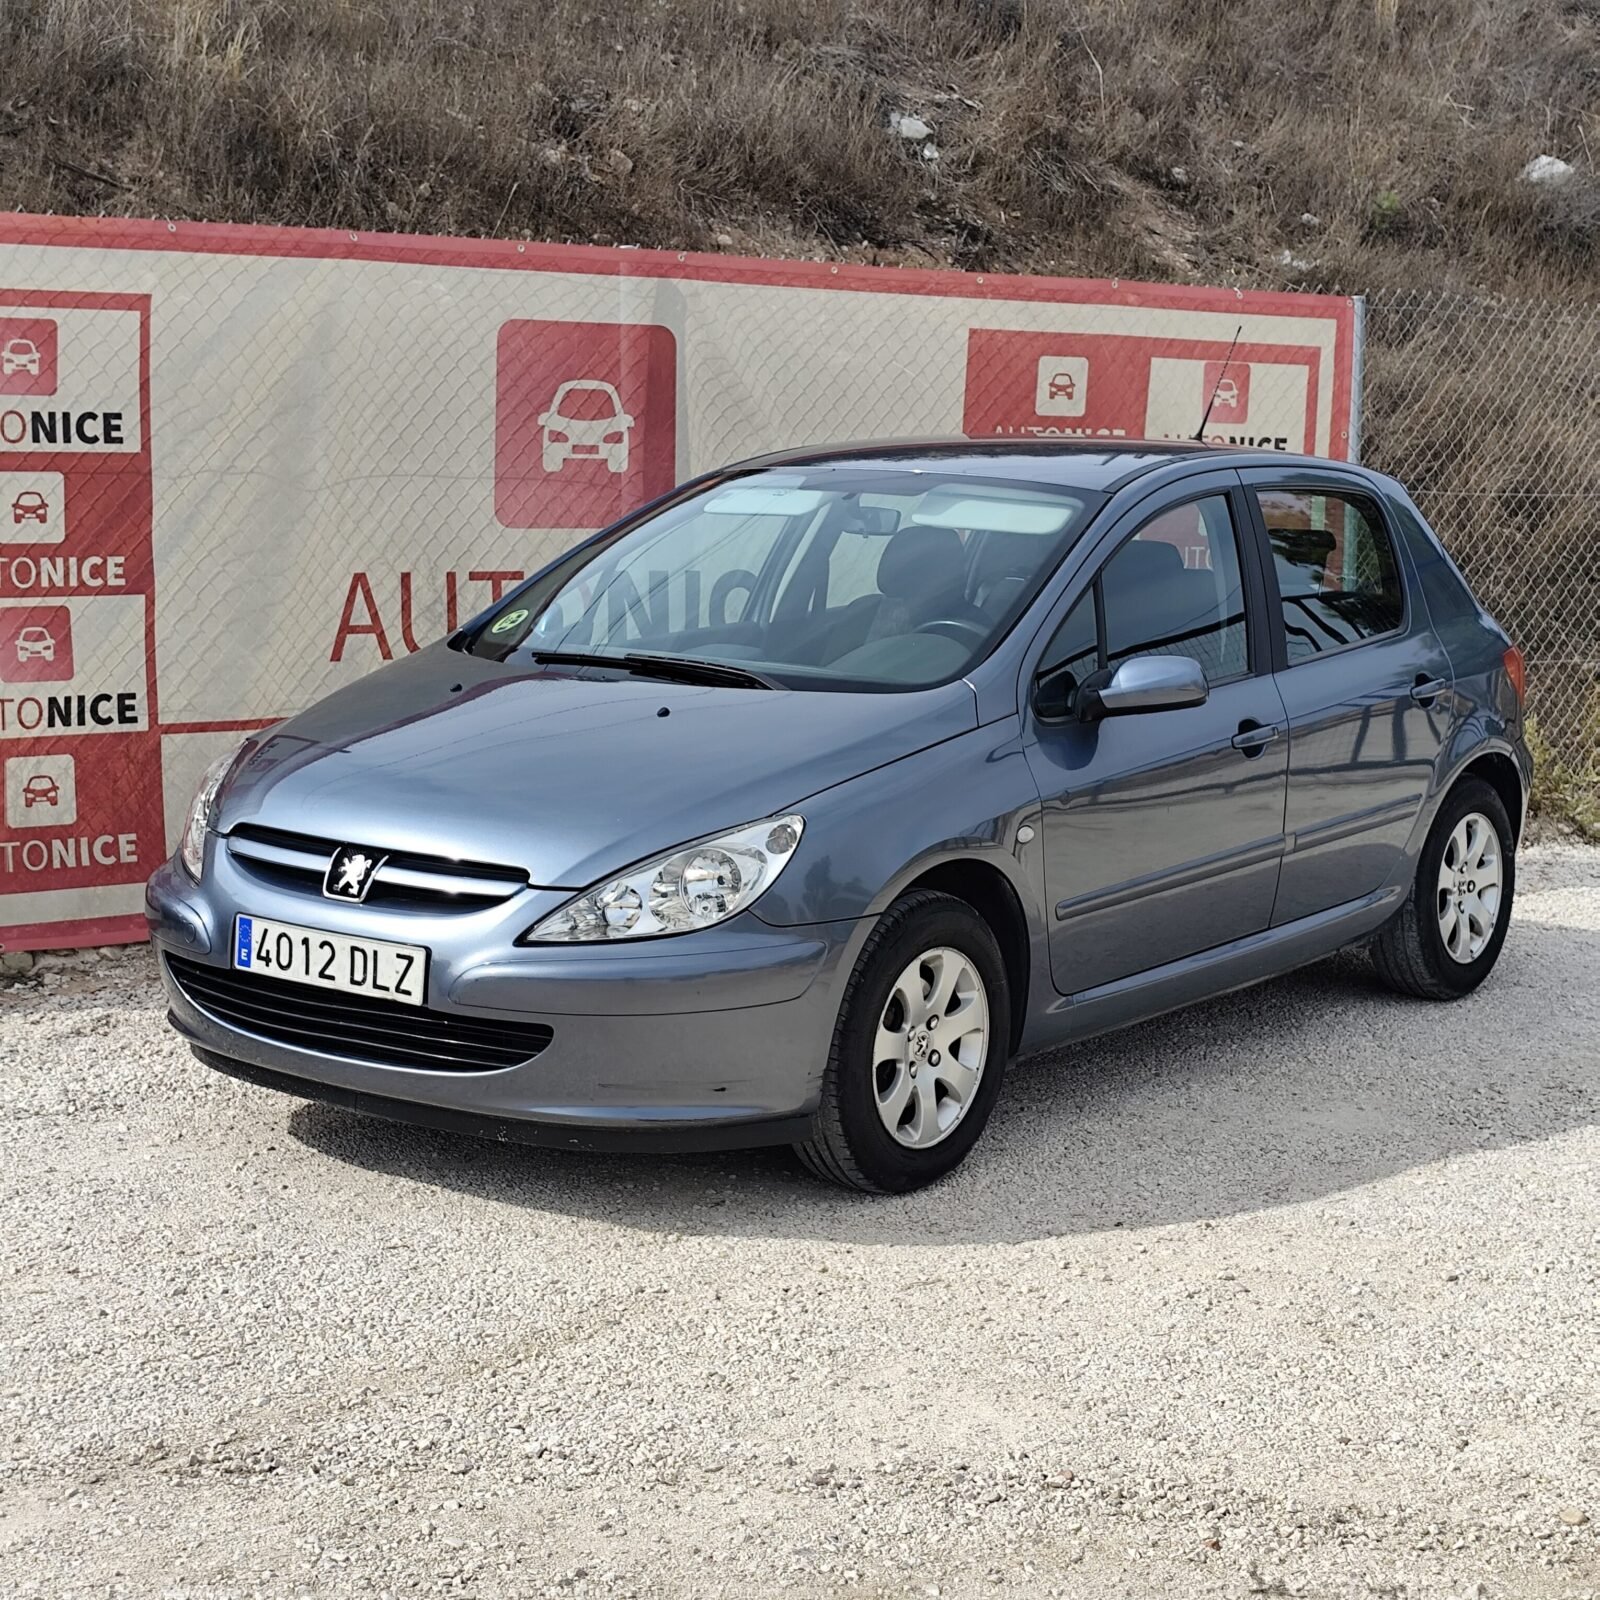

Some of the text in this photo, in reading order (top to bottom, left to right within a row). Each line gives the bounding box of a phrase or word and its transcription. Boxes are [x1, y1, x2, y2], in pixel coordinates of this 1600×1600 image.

[0, 692, 139, 731] TONICE
[0, 833, 138, 873] TONICE
[240, 928, 415, 997] E 4012 DLZ
